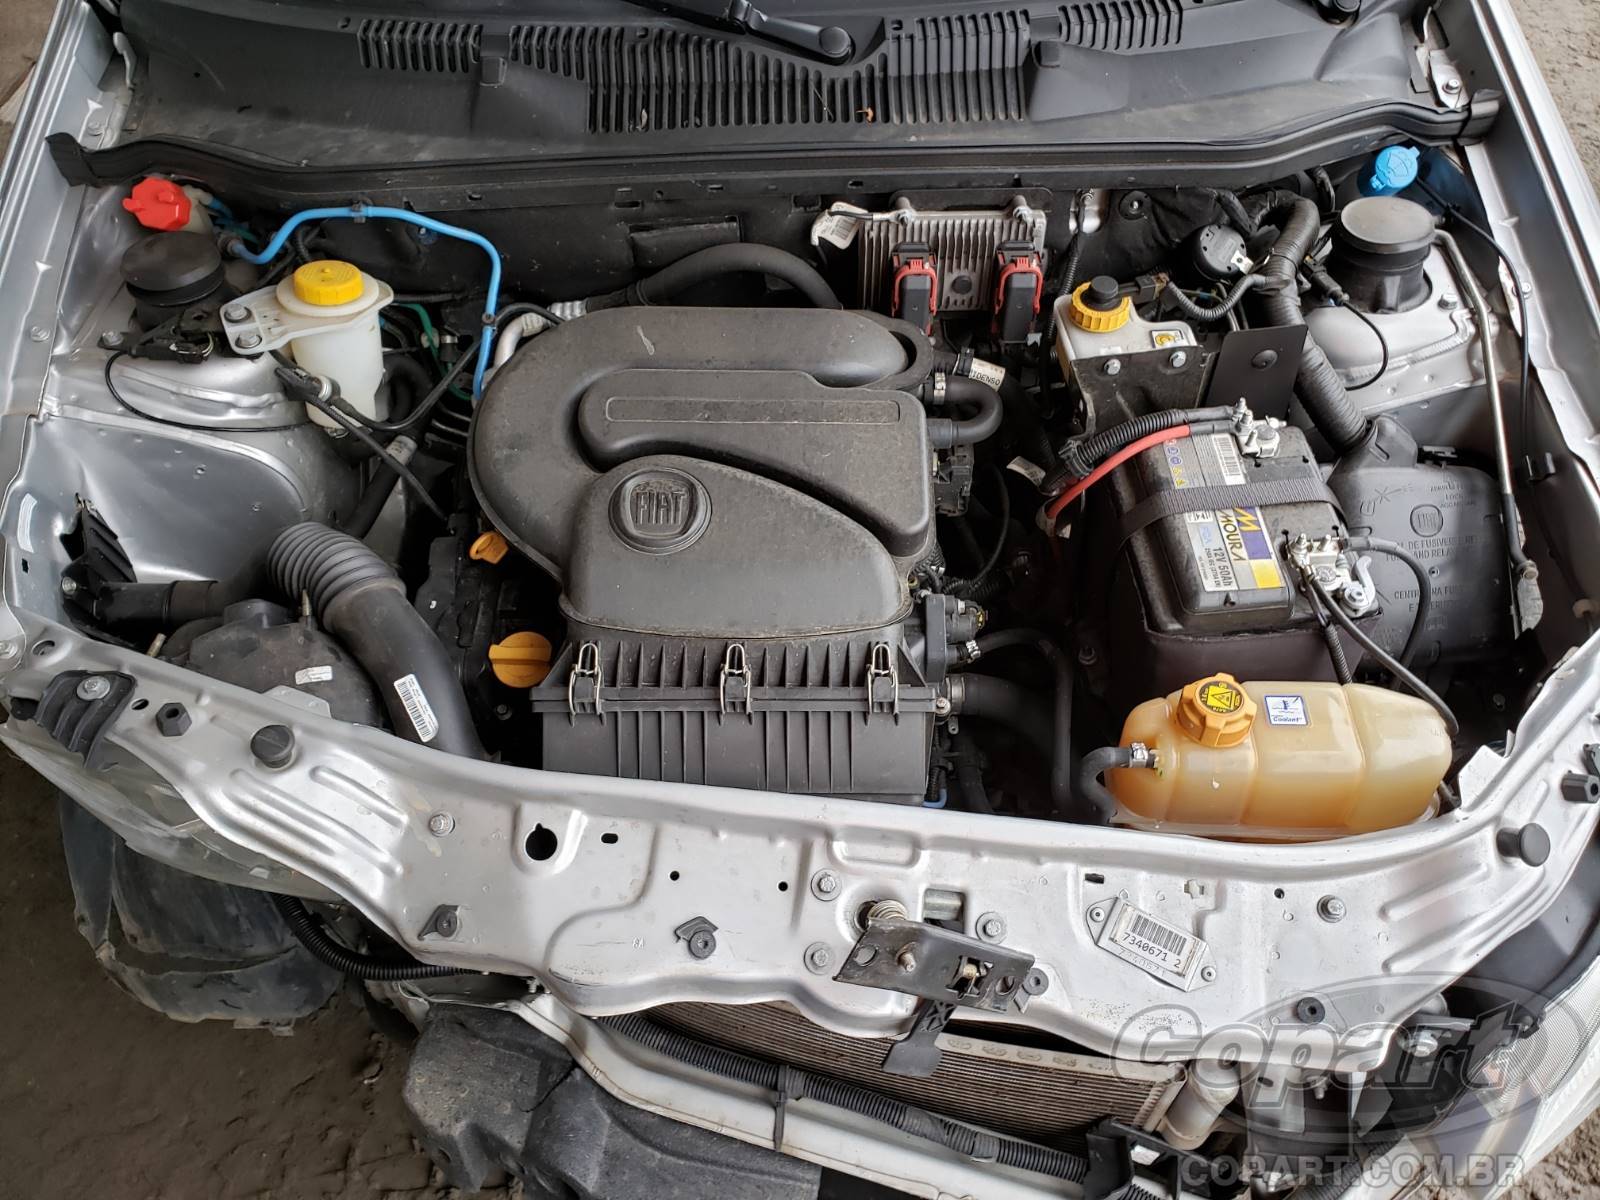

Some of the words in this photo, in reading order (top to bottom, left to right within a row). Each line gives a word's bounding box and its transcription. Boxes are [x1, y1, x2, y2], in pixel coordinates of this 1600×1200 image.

[634, 487, 688, 525] FIAT
[1213, 546, 1227, 563] 12V
[1219, 510, 1247, 562] MOURA
[1218, 564, 1233, 587] 50Ah
[1122, 932, 1168, 962] 7340671
[1174, 958, 1182, 969] 2
